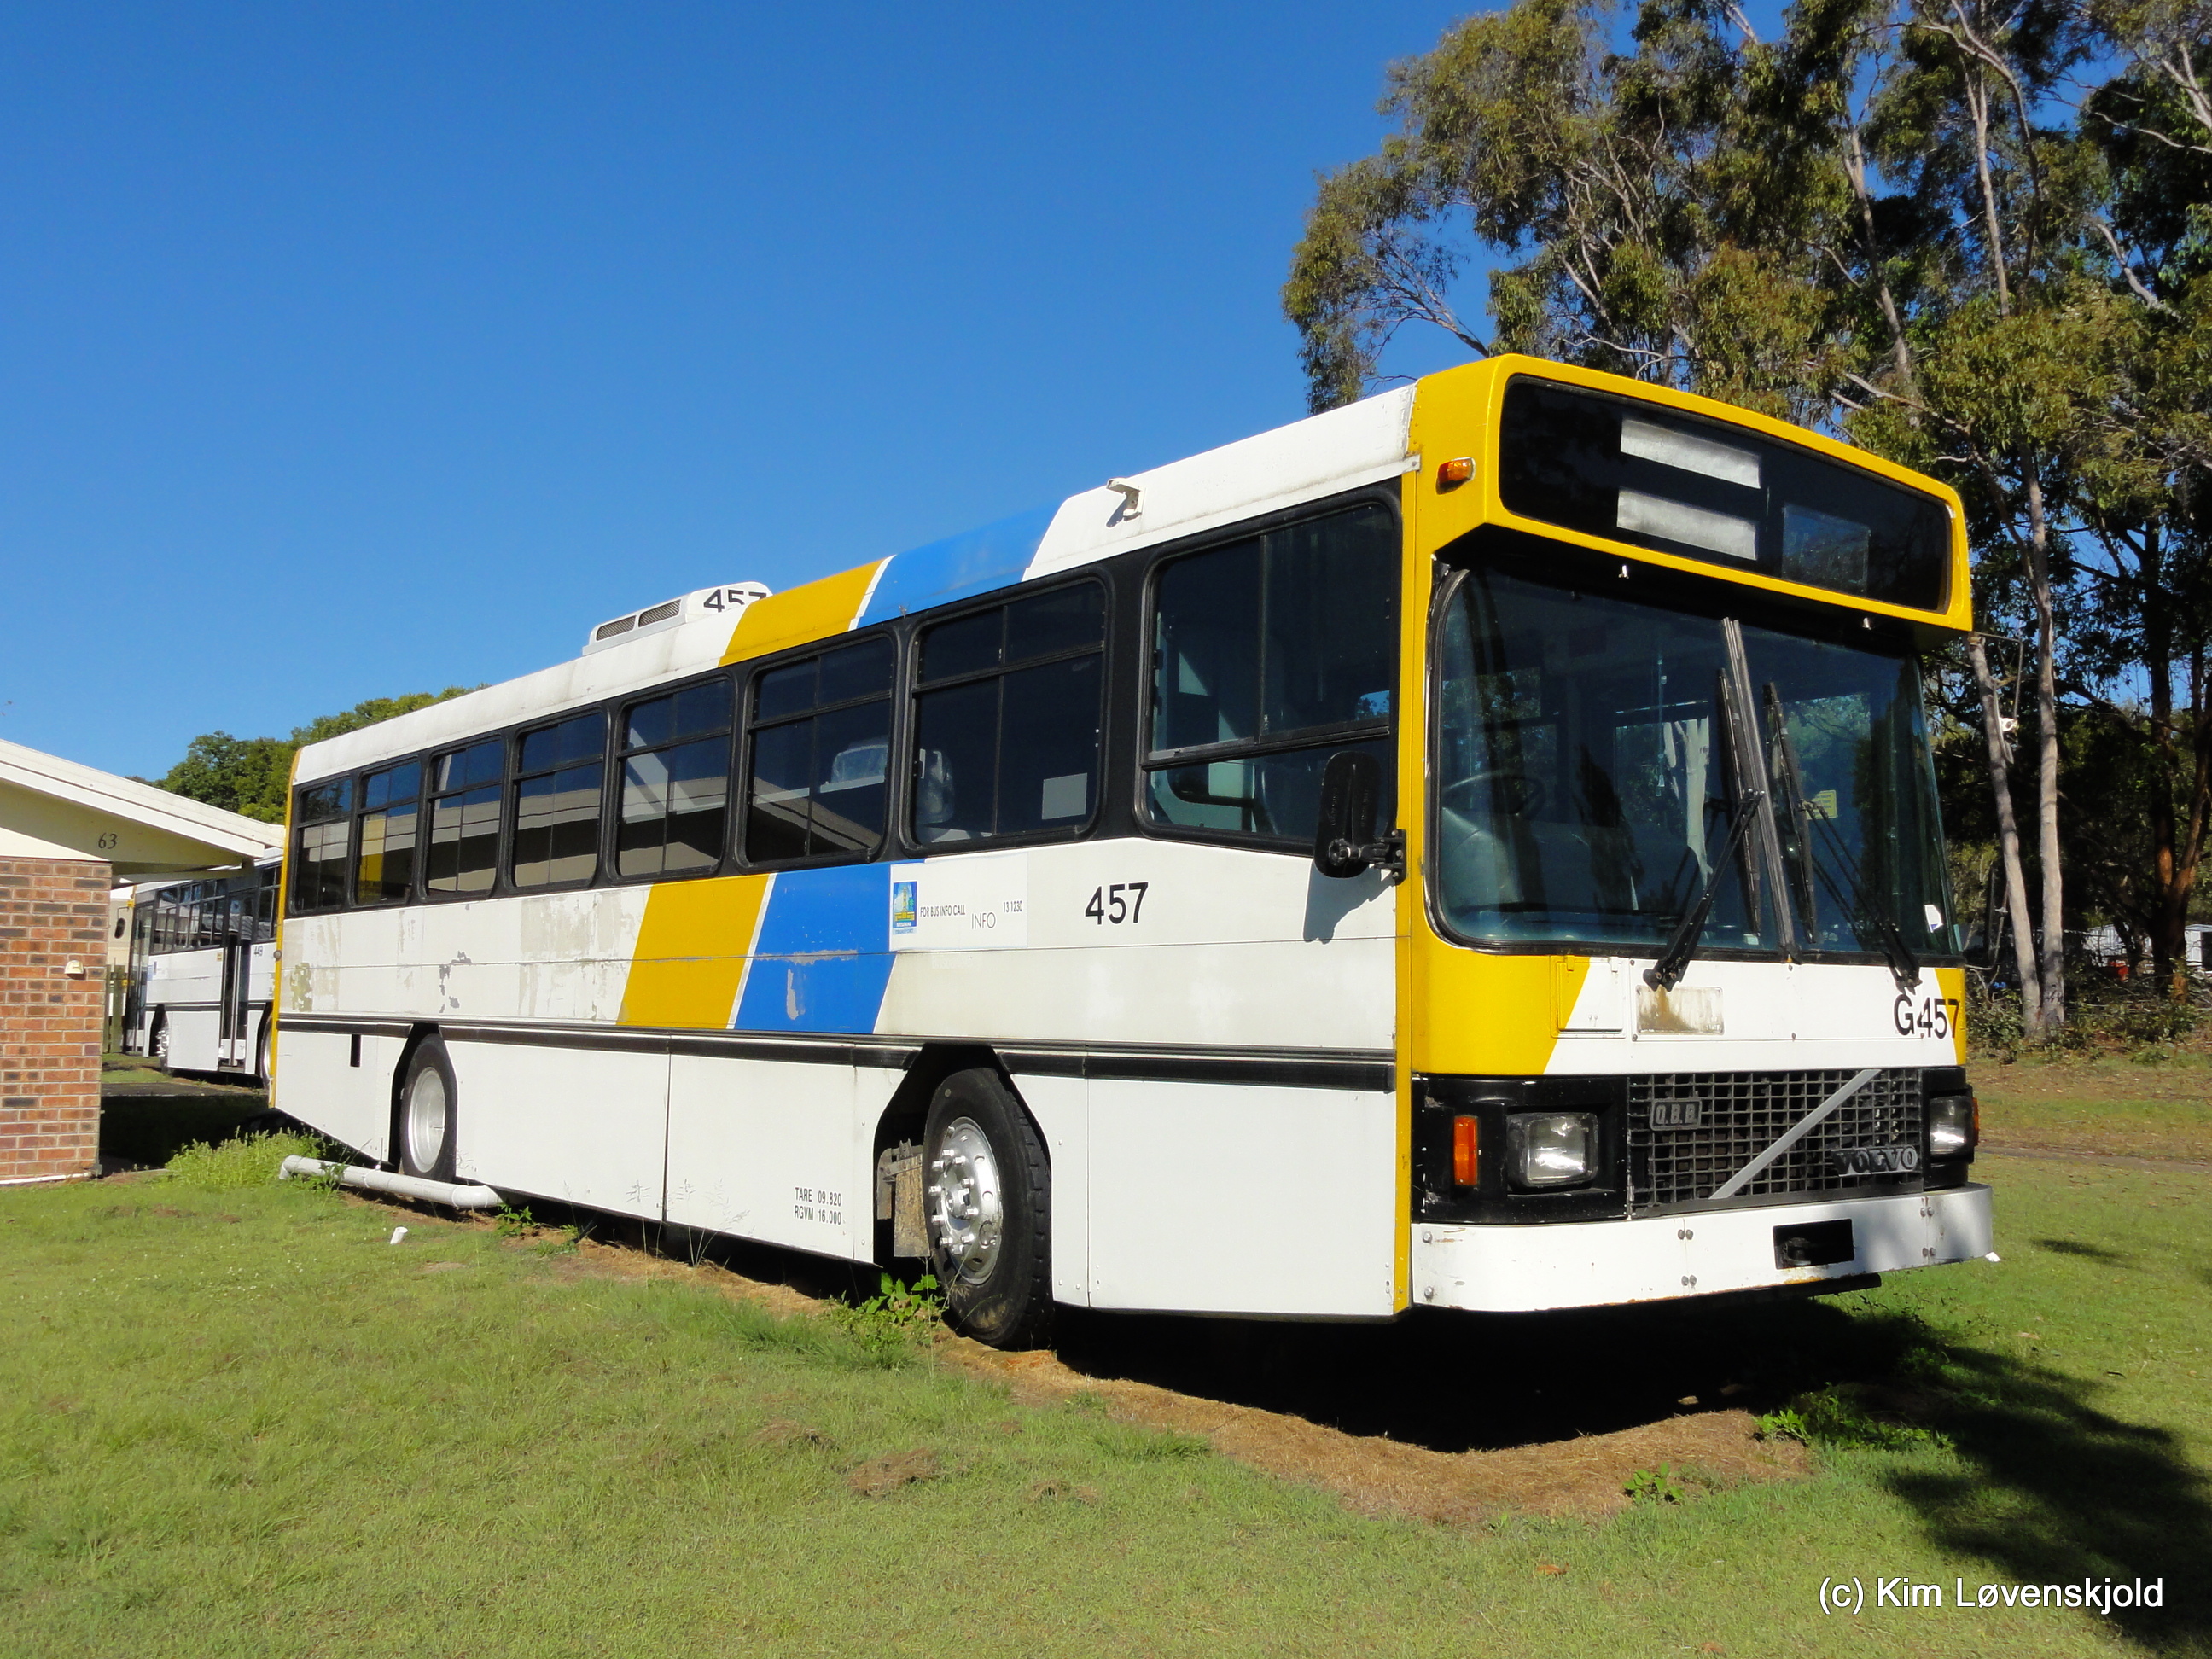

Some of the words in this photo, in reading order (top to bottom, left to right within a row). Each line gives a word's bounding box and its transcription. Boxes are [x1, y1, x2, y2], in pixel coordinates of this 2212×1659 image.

[98, 832, 117, 850] 63
[920, 906, 929, 917] FOR
[930, 906, 939, 917] BUS
[940, 905, 952, 917] INFO
[953, 905, 965, 916] CALL
[1003, 901, 1010, 913] 13
[1010, 900, 1022, 912] 1230
[1085, 882, 1149, 925] 457
[971, 911, 996, 929] INFO
[1894, 993, 1960, 1039] G457
[1831, 1147, 1918, 1173] VOLVO
[795, 1187, 812, 1202] TARE
[794, 1205, 814, 1220] RGVM
